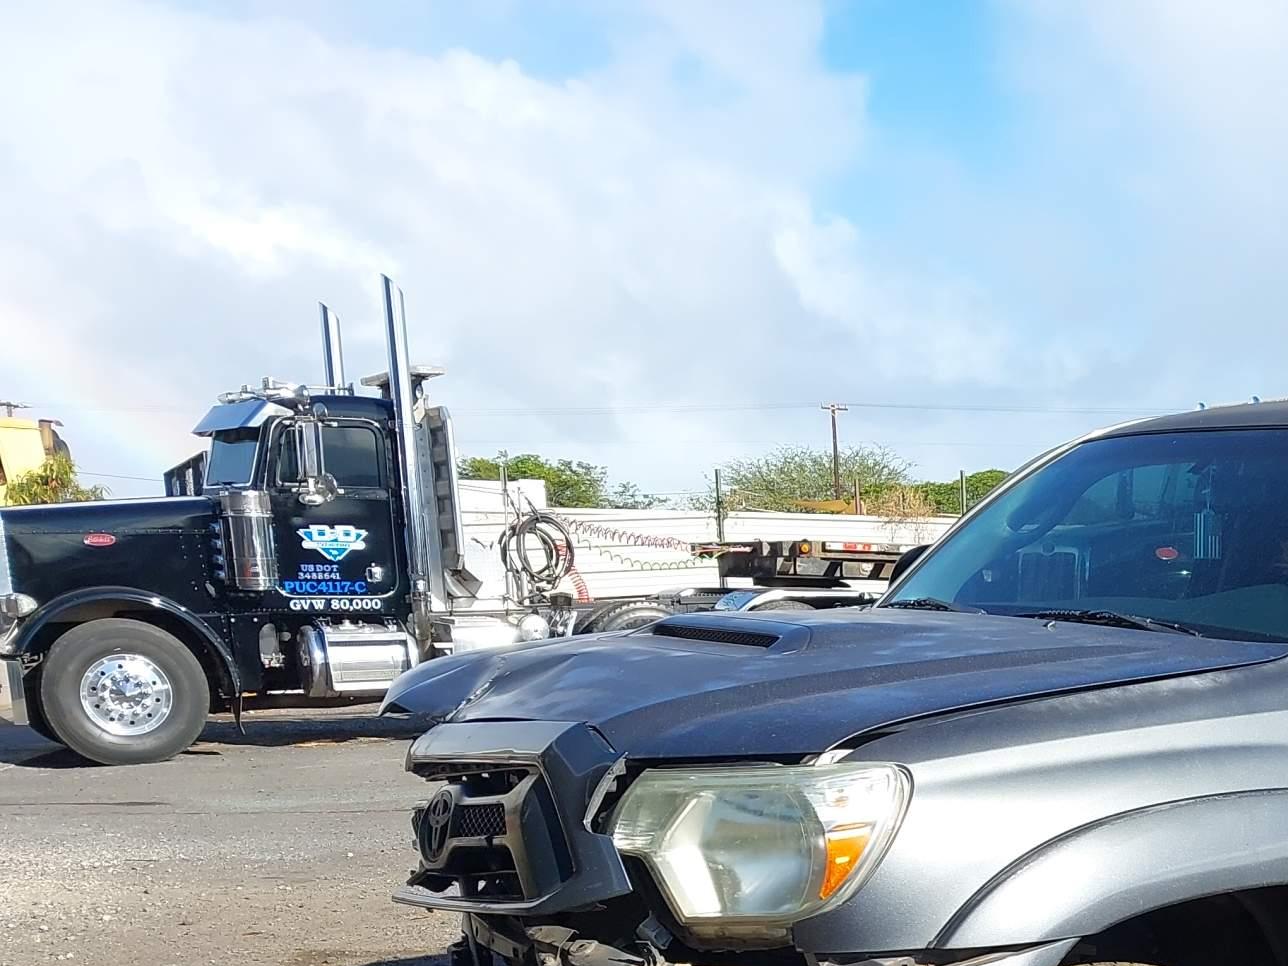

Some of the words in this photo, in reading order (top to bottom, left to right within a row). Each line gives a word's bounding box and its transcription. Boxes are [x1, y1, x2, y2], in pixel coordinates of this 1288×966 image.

[300, 564, 314, 572] US
[315, 564, 339, 572] DOT
[284, 581, 367, 593] PUC4117-C
[289, 599, 325, 610] GVW
[331, 599, 381, 611] 80,000
